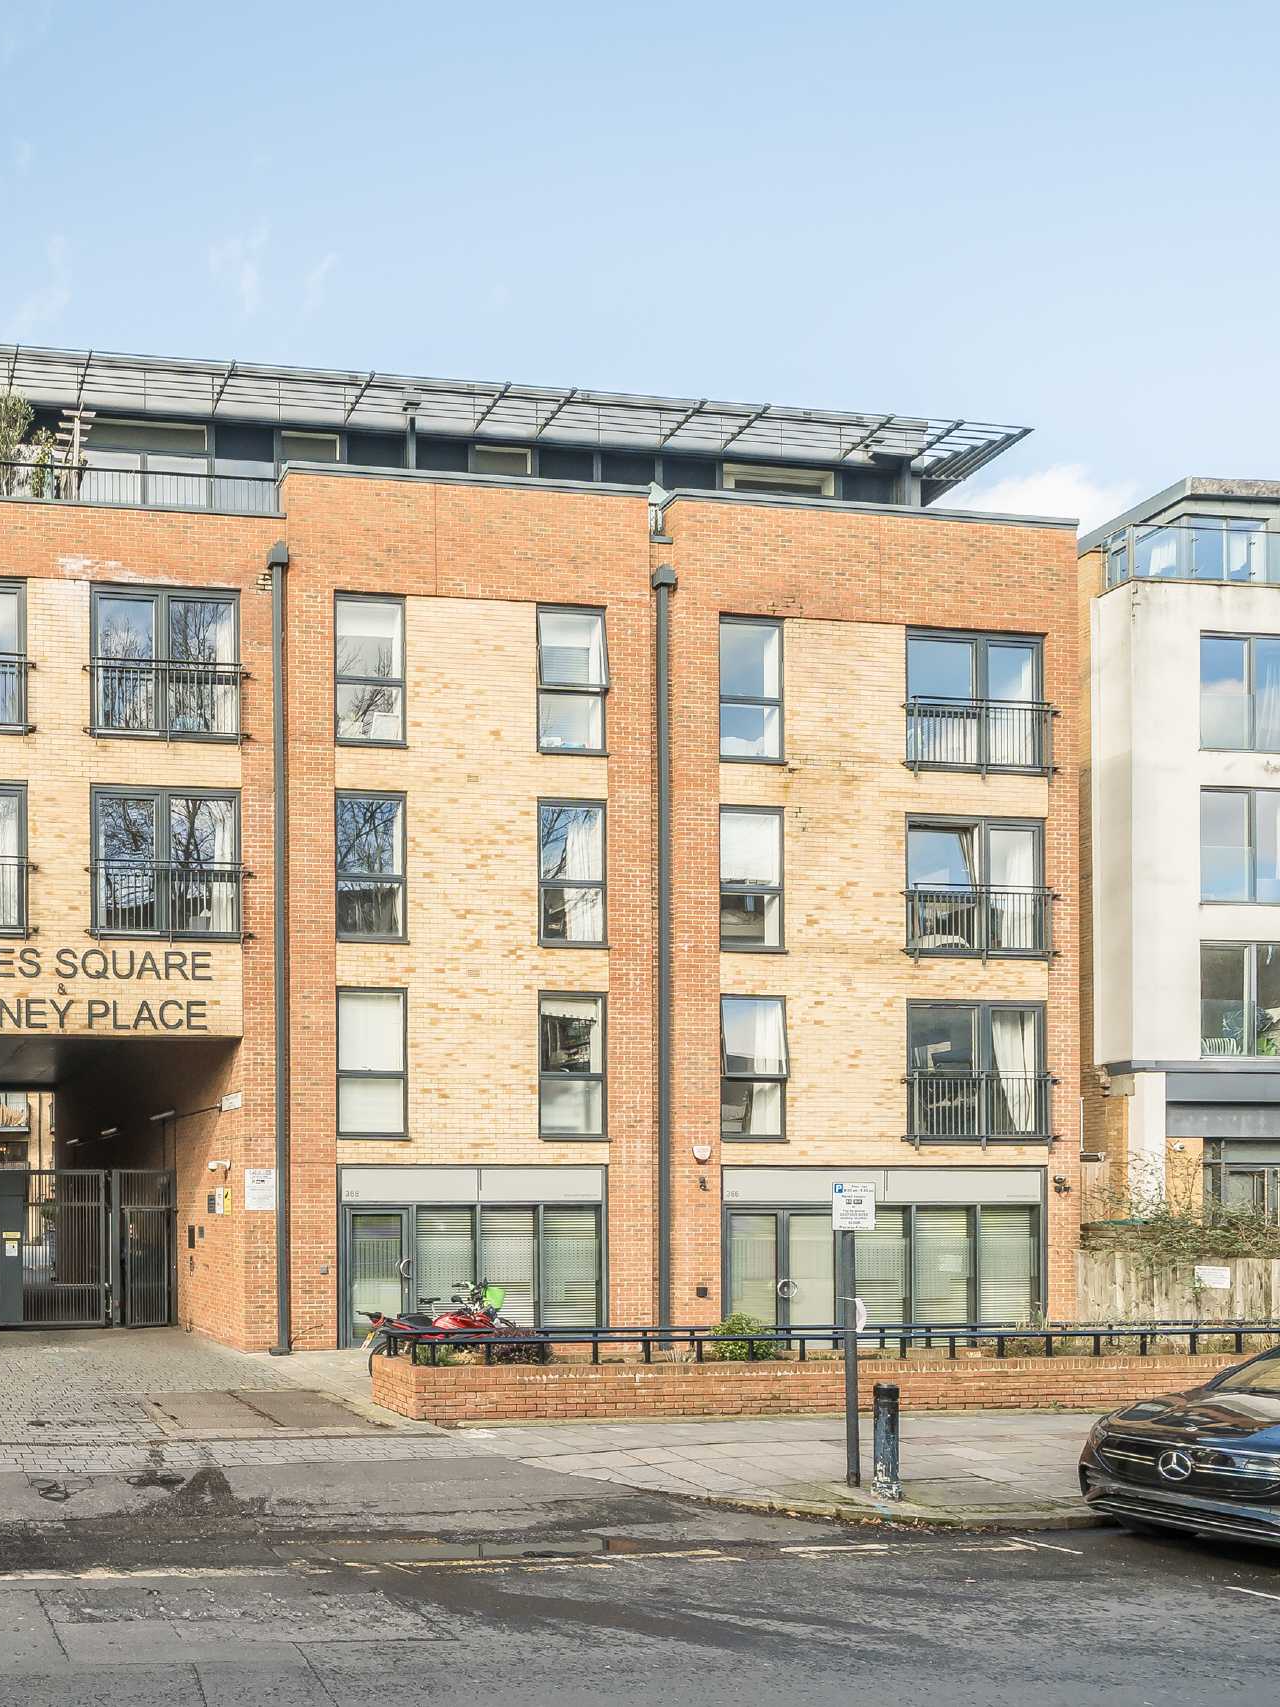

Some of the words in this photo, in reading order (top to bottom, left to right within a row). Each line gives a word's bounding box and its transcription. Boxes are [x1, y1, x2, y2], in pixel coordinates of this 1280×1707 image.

[55, 948, 212, 980] SQUARE
[57, 982, 67, 996] &
[88, 1000, 207, 1030] PLACE
[835, 1184, 842, 1193] P
